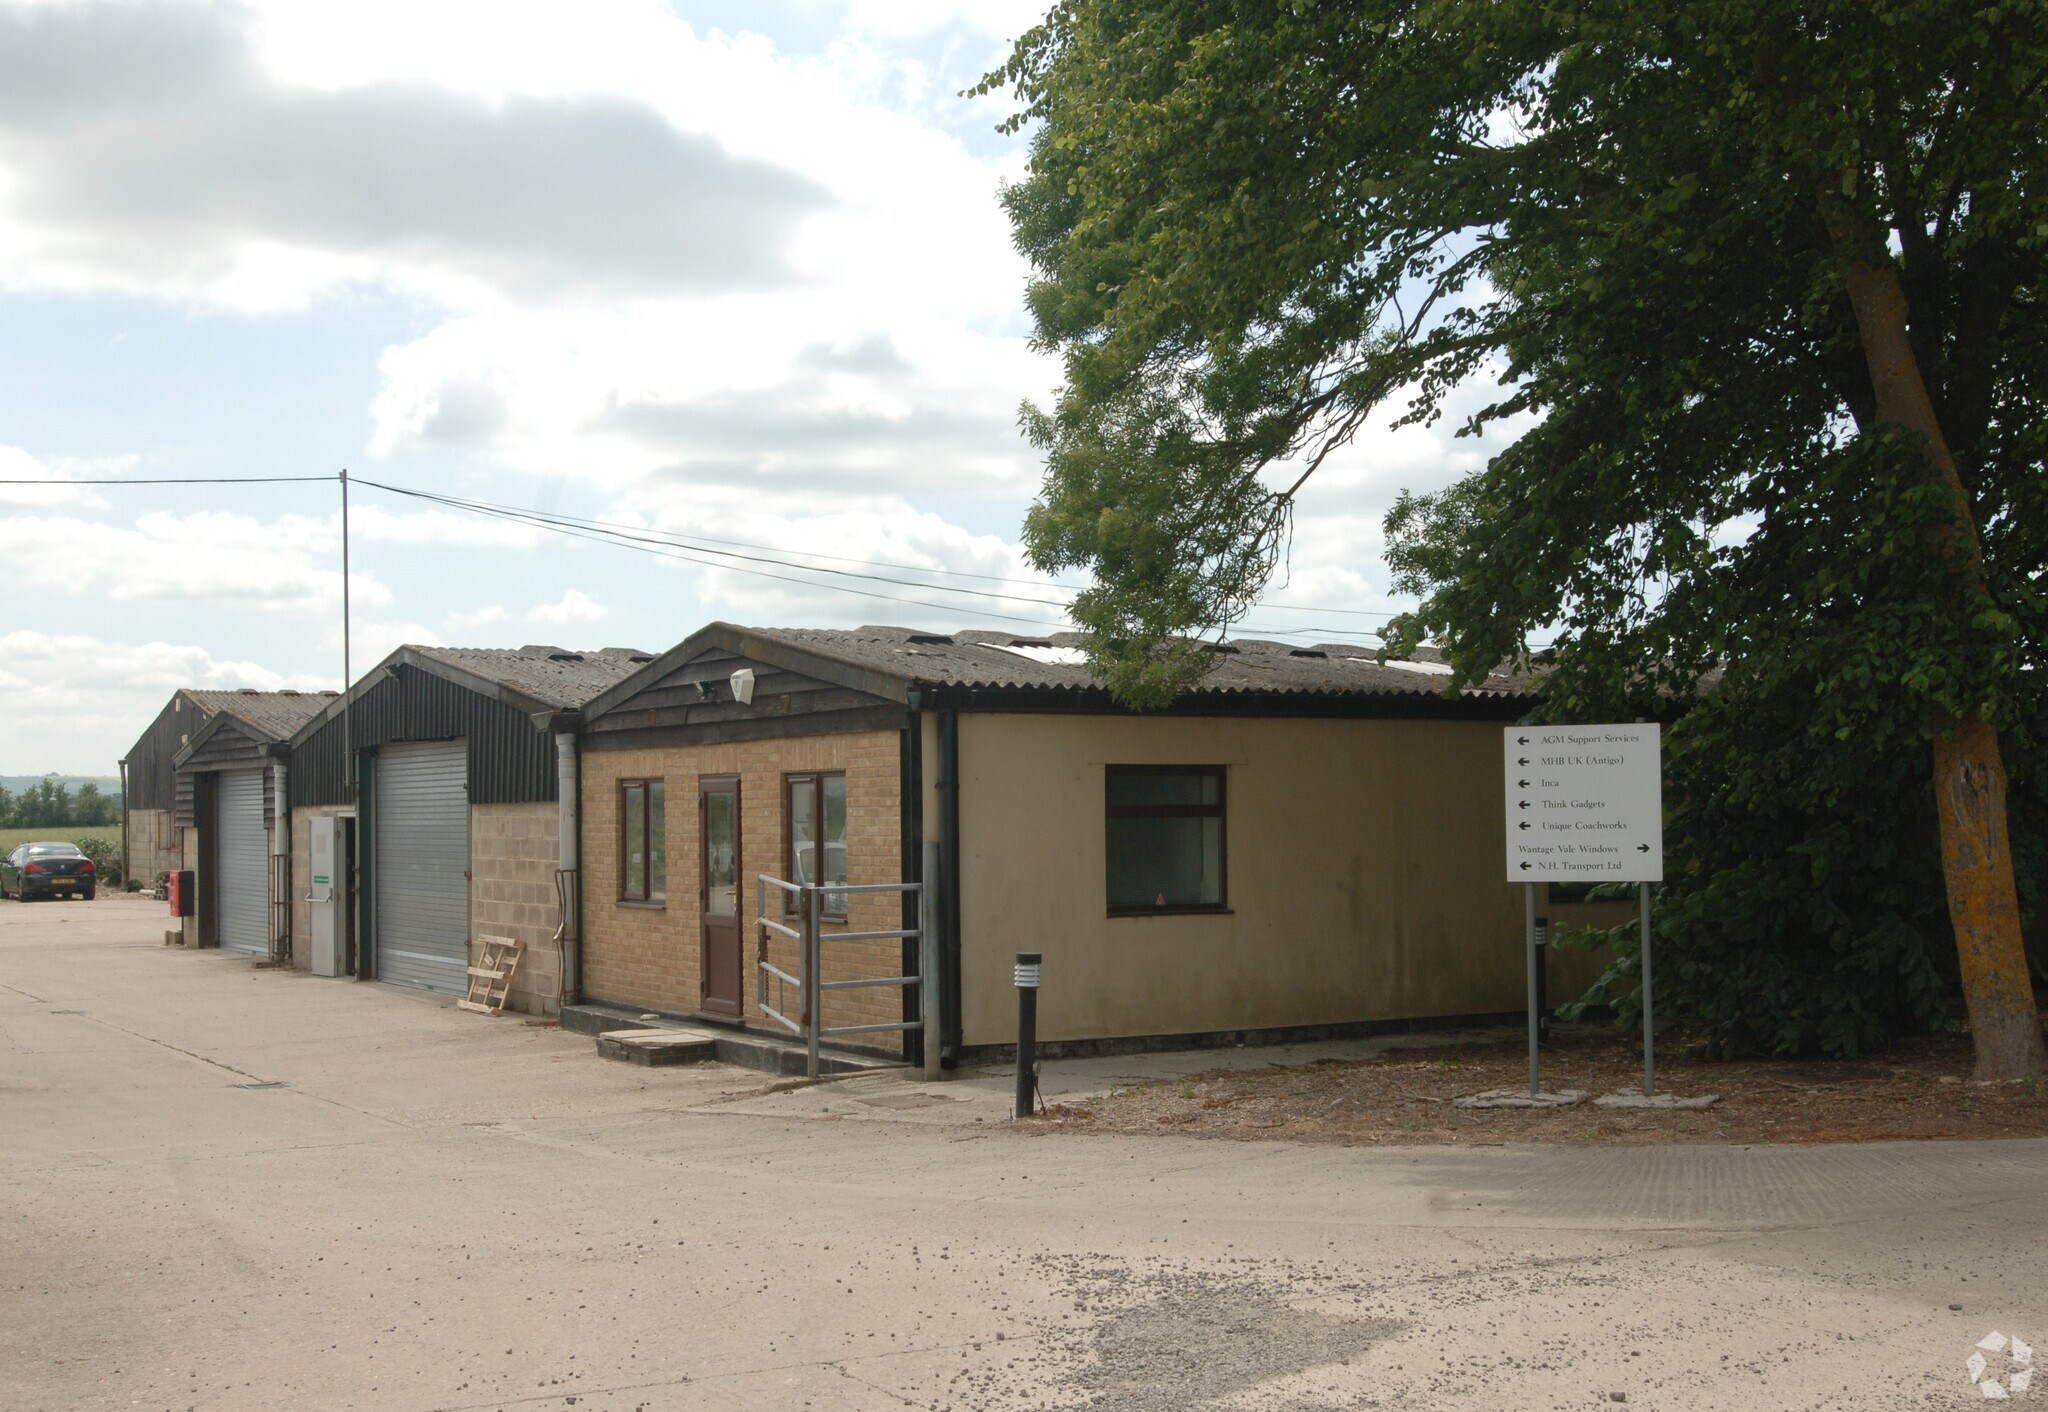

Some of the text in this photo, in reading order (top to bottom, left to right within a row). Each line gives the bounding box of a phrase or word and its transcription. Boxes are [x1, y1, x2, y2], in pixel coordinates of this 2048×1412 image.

[1541, 734, 1639, 744] AGM Support Services
[1541, 755, 1624, 765] MHB UK (Antigo)
[1541, 779, 1559, 787] Inca
[1542, 800, 1605, 809] Think Gadgets
[1542, 821, 1627, 831] Unique Coachworks
[1519, 845, 1618, 854] Wantage Vale Windows
[1539, 861, 1621, 871] N.H. Transport Ltd
